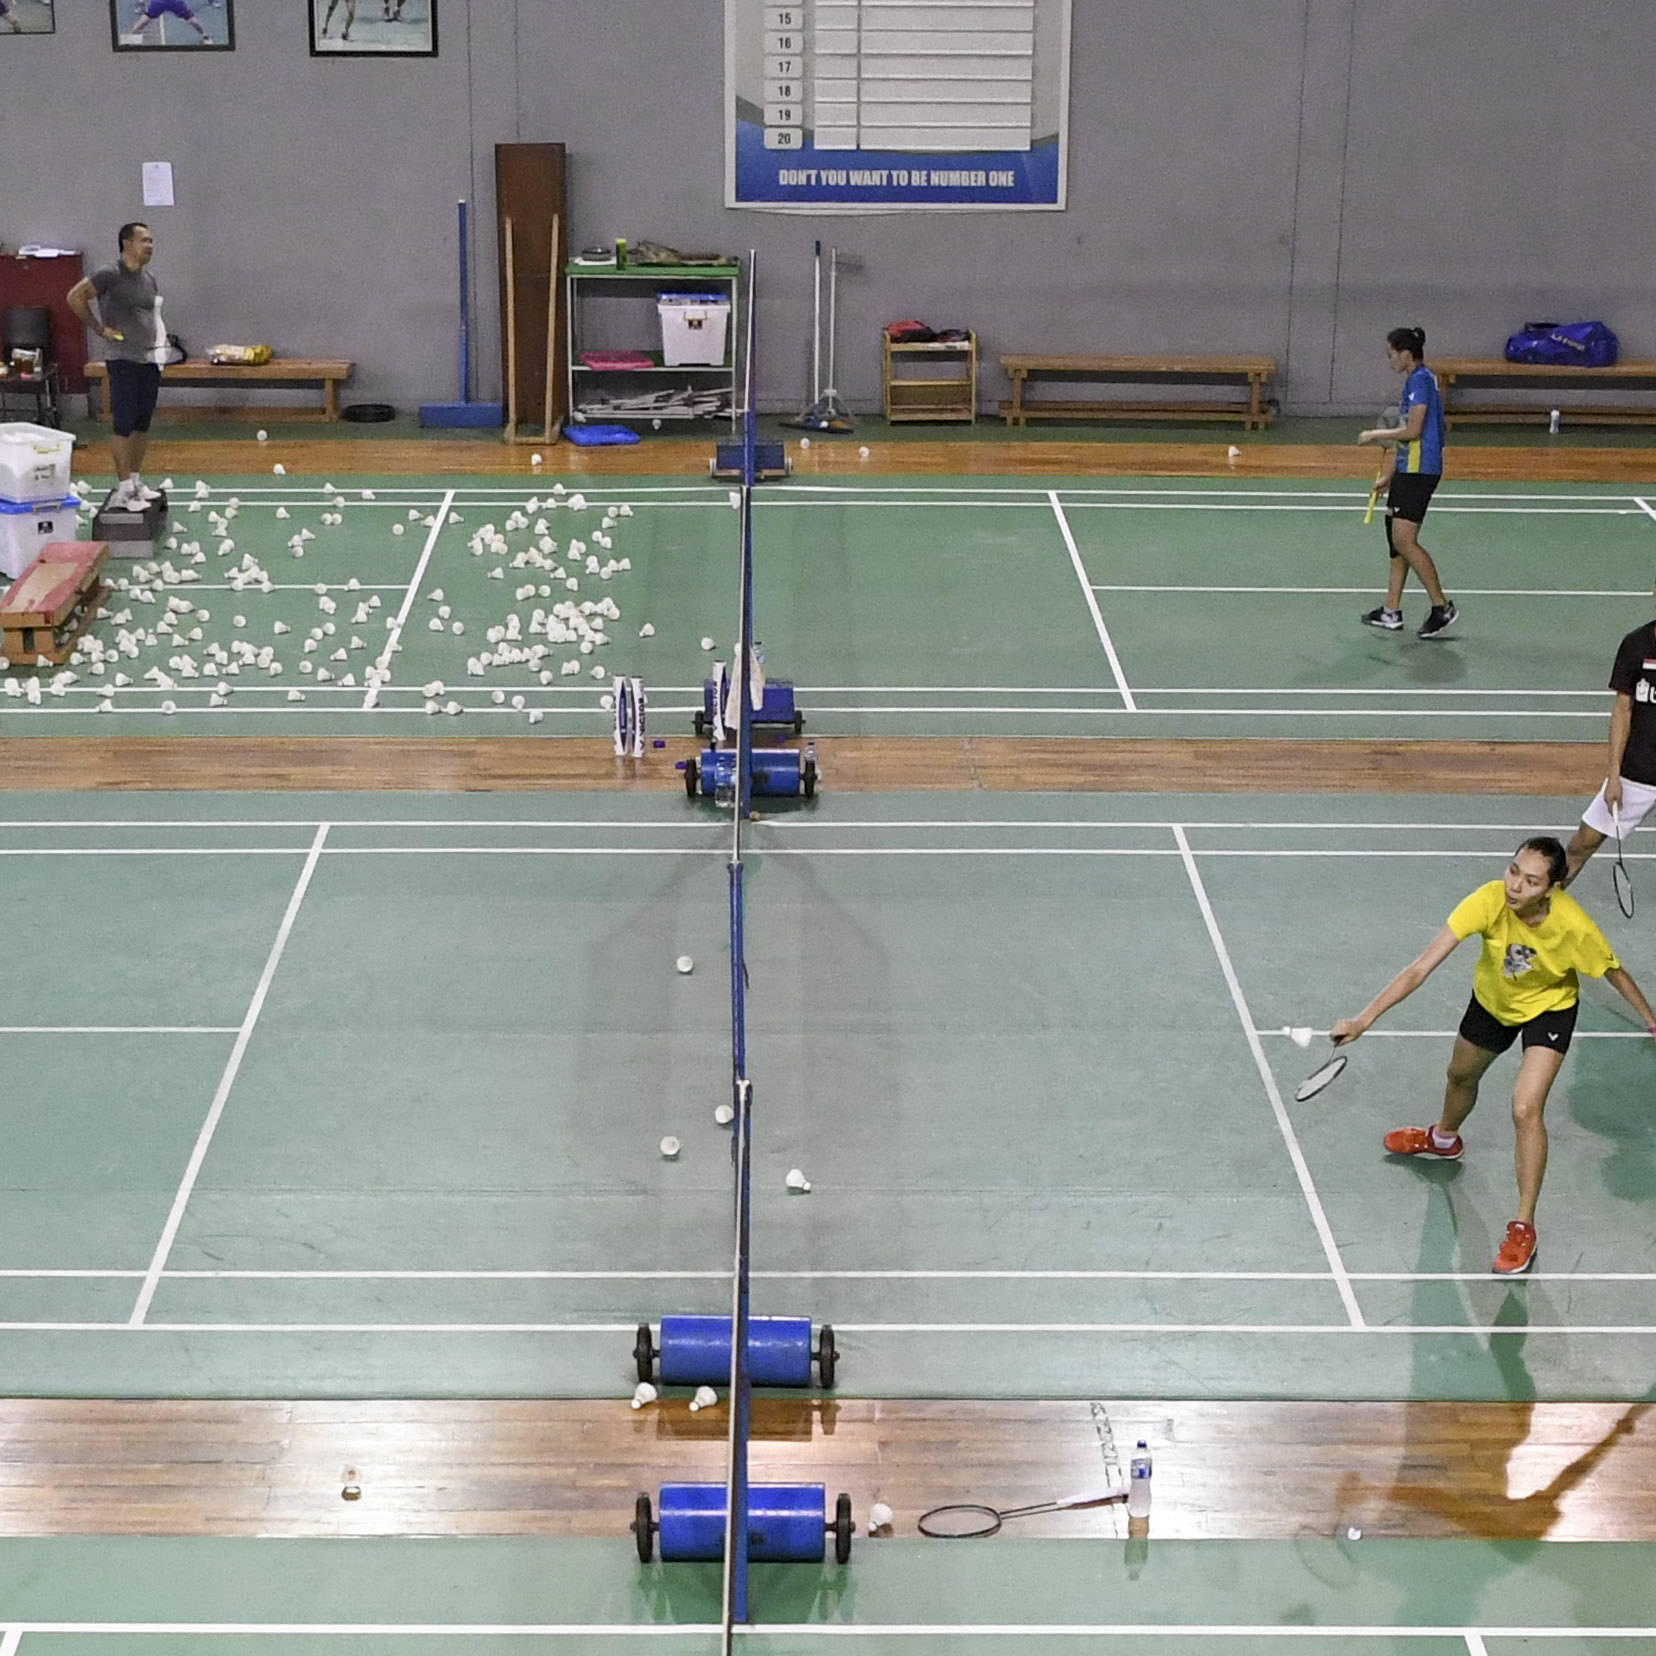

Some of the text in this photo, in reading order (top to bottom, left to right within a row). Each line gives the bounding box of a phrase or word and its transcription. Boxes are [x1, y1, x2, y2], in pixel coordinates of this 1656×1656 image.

[778, 12, 792, 25] 15
[778, 37, 792, 49] 16
[778, 61, 792, 73] 17
[778, 85, 792, 97] 18
[778, 109, 792, 121] 19
[777, 132, 792, 145] 20
[779, 169, 1015, 187] DON'T YOU WANT TO BE NUMBER ONE
